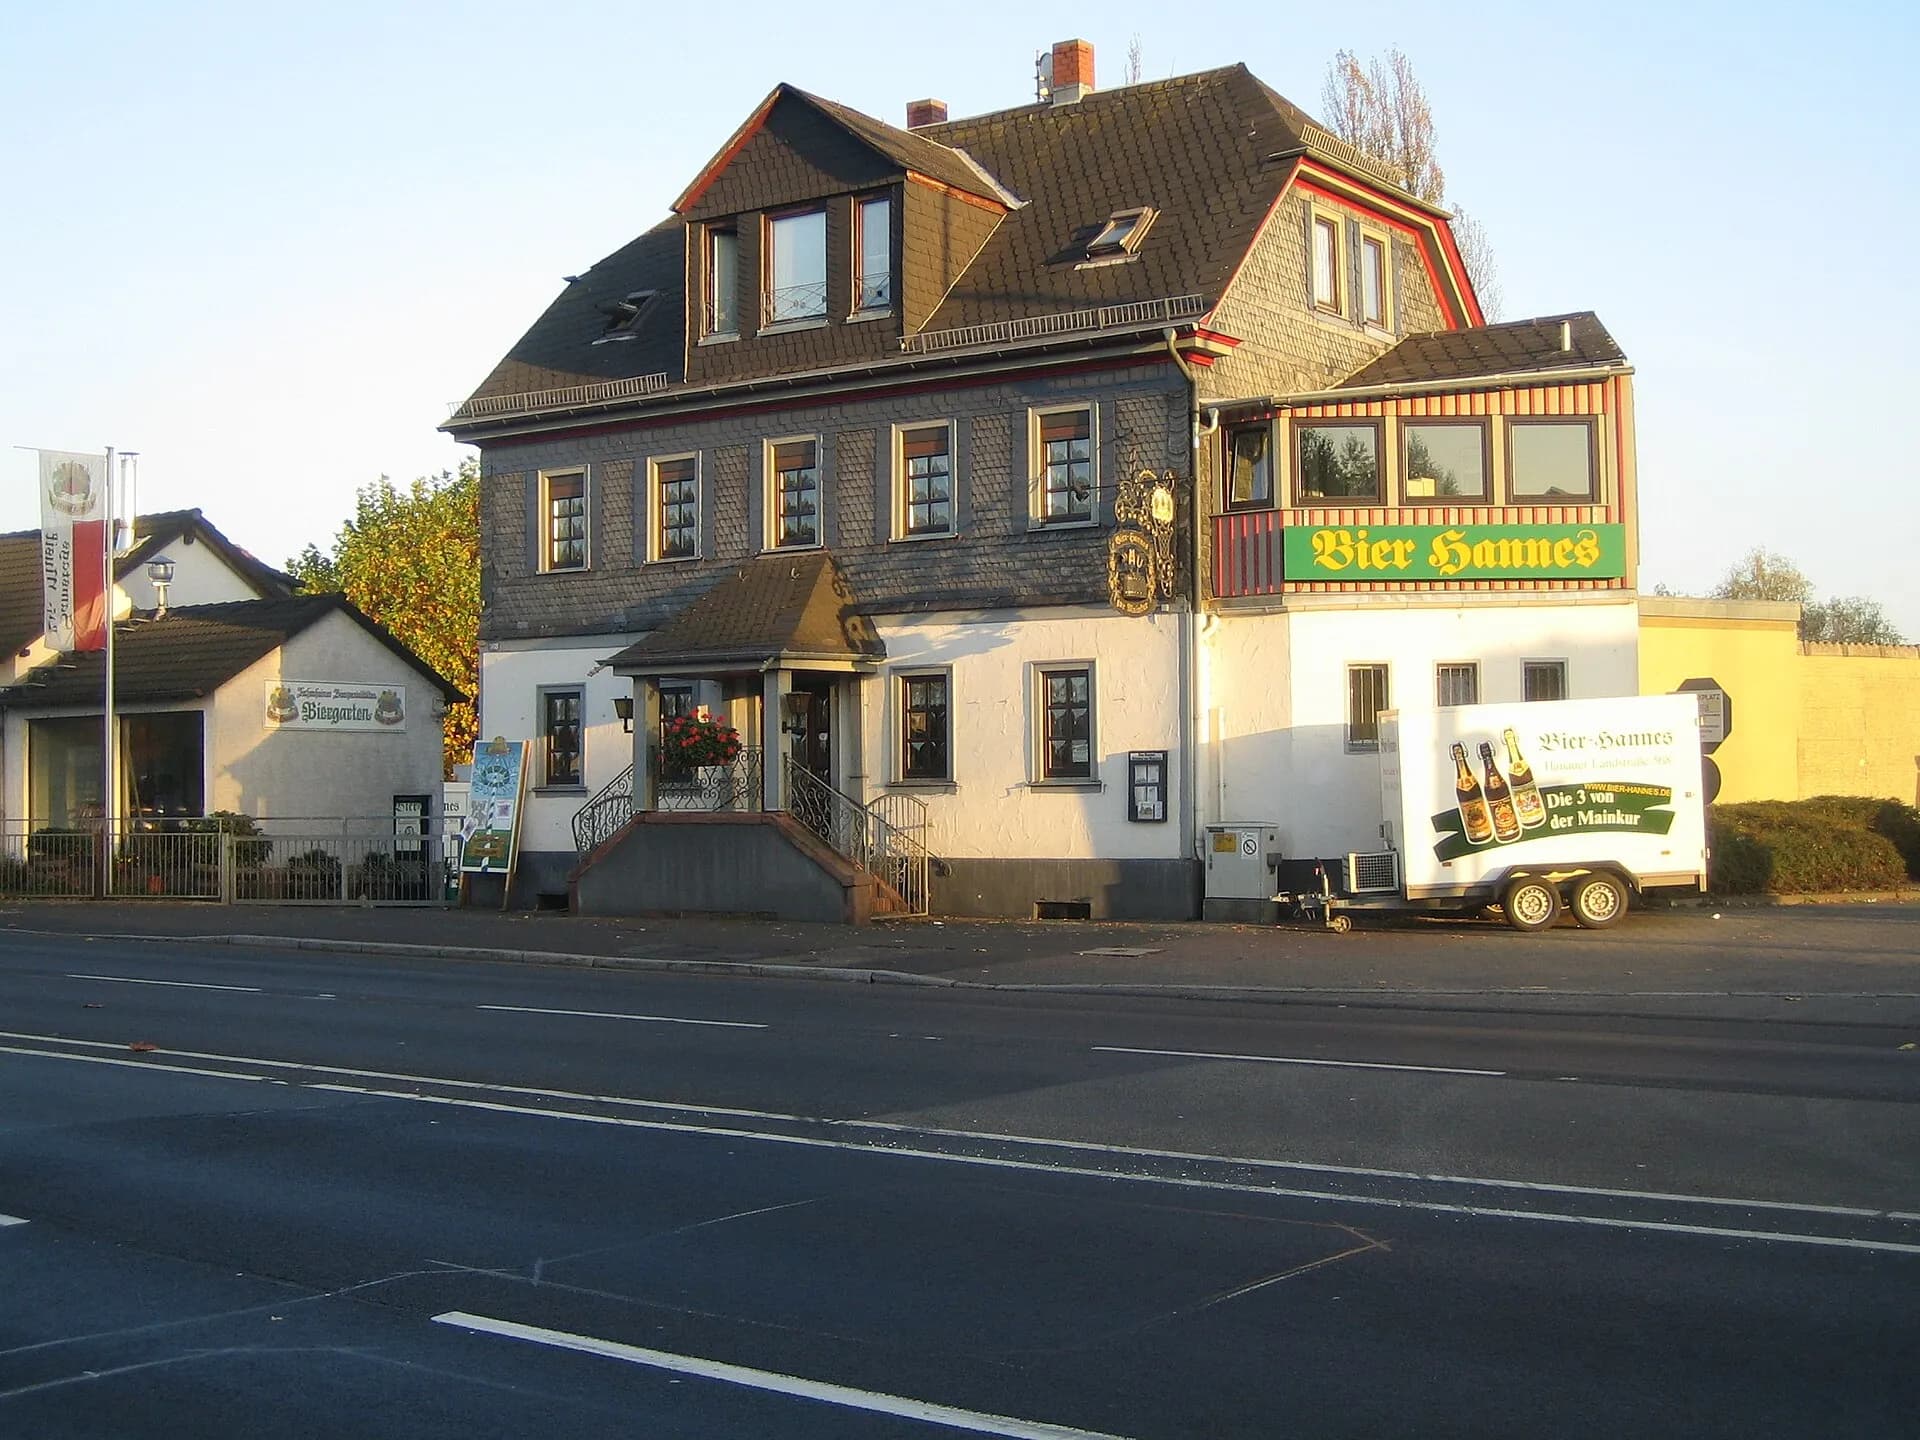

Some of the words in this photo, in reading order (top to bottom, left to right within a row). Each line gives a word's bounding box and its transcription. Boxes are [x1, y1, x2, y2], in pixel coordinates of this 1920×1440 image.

[1311, 529, 1416, 570] Bier
[1429, 529, 1600, 576] Hannes
[301, 702, 373, 723] Biergarten
[1538, 731, 1673, 751] Bier-Hannes
[1547, 793, 1573, 809] Die
[1577, 790, 1586, 806] 3
[1589, 791, 1614, 804] von
[1583, 783, 1671, 797] WWW.BIER-HANNES.DE
[1550, 813, 1574, 830] der
[1577, 809, 1641, 827] Mainkur
